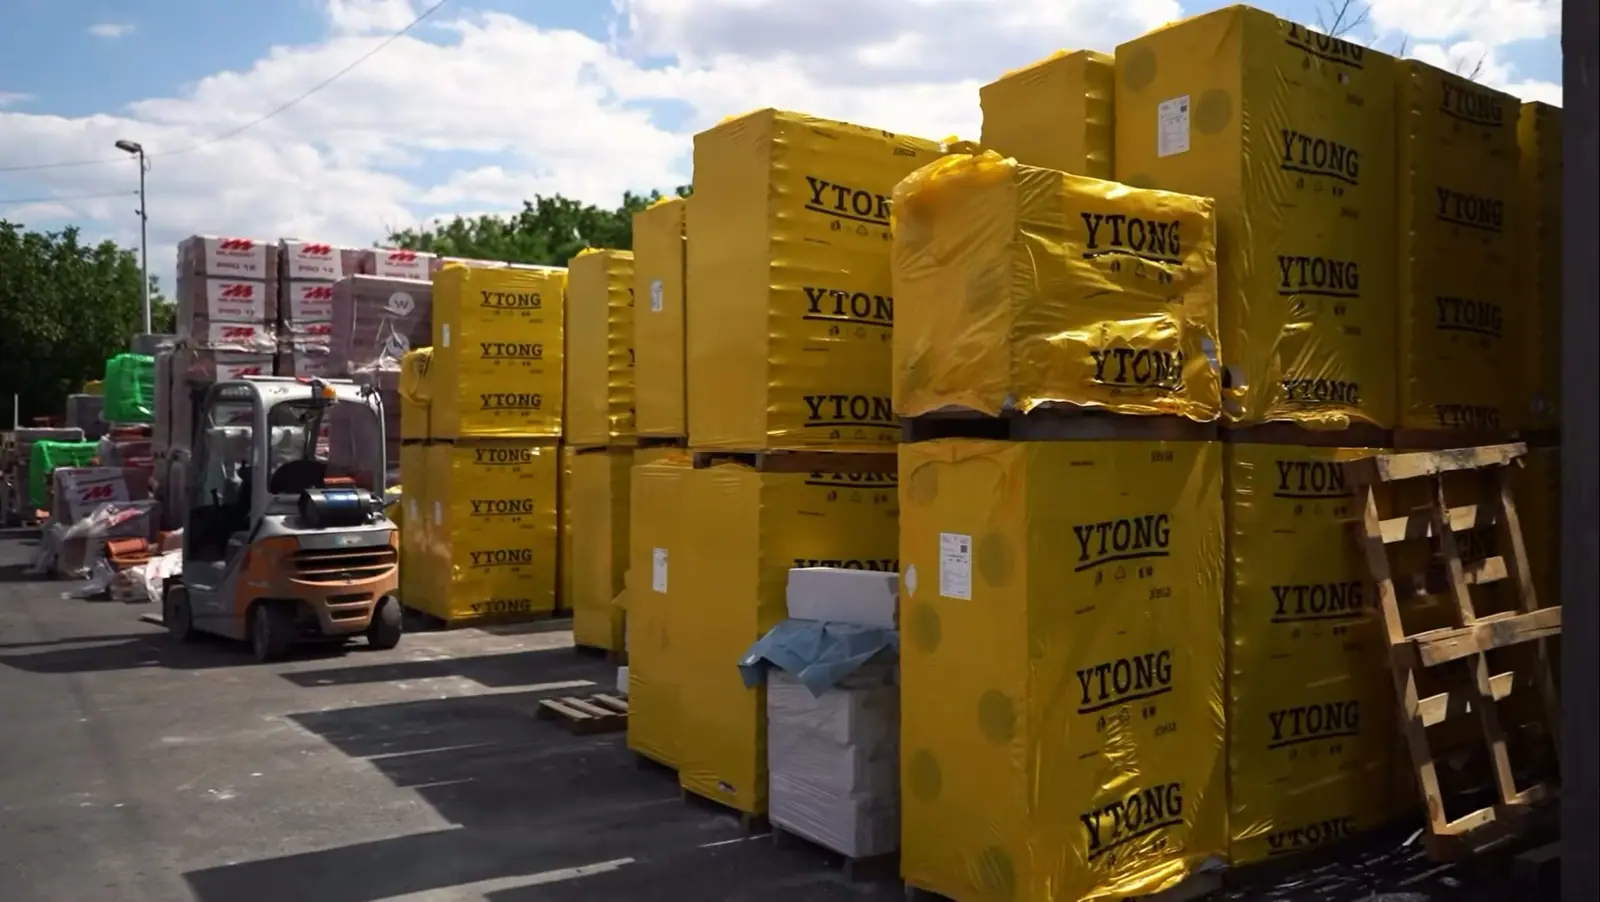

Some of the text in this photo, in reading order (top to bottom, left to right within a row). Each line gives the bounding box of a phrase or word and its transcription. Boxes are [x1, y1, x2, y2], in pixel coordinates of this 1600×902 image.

[1281, 128, 1359, 178] YTONG
[1436, 186, 1504, 226] YTONG
[1081, 211, 1181, 256] YTONG
[1277, 255, 1359, 290] YTONG
[480, 290, 541, 307] YTONG
[1436, 296, 1502, 329] YTONG
[480, 342, 542, 358] YTONG
[1091, 348, 1183, 385] YTONG
[480, 393, 541, 408] YTONG
[1281, 378, 1359, 405] YTONG
[475, 448, 531, 462] YTONG
[470, 498, 533, 513] YTONG
[1073, 513, 1170, 562] YTONG
[469, 548, 532, 564] YTONG
[1271, 581, 1363, 614] YTONG
[1076, 650, 1173, 705] YTONG
[1268, 700, 1360, 741] YTONG
[1080, 782, 1183, 851] YTONG
